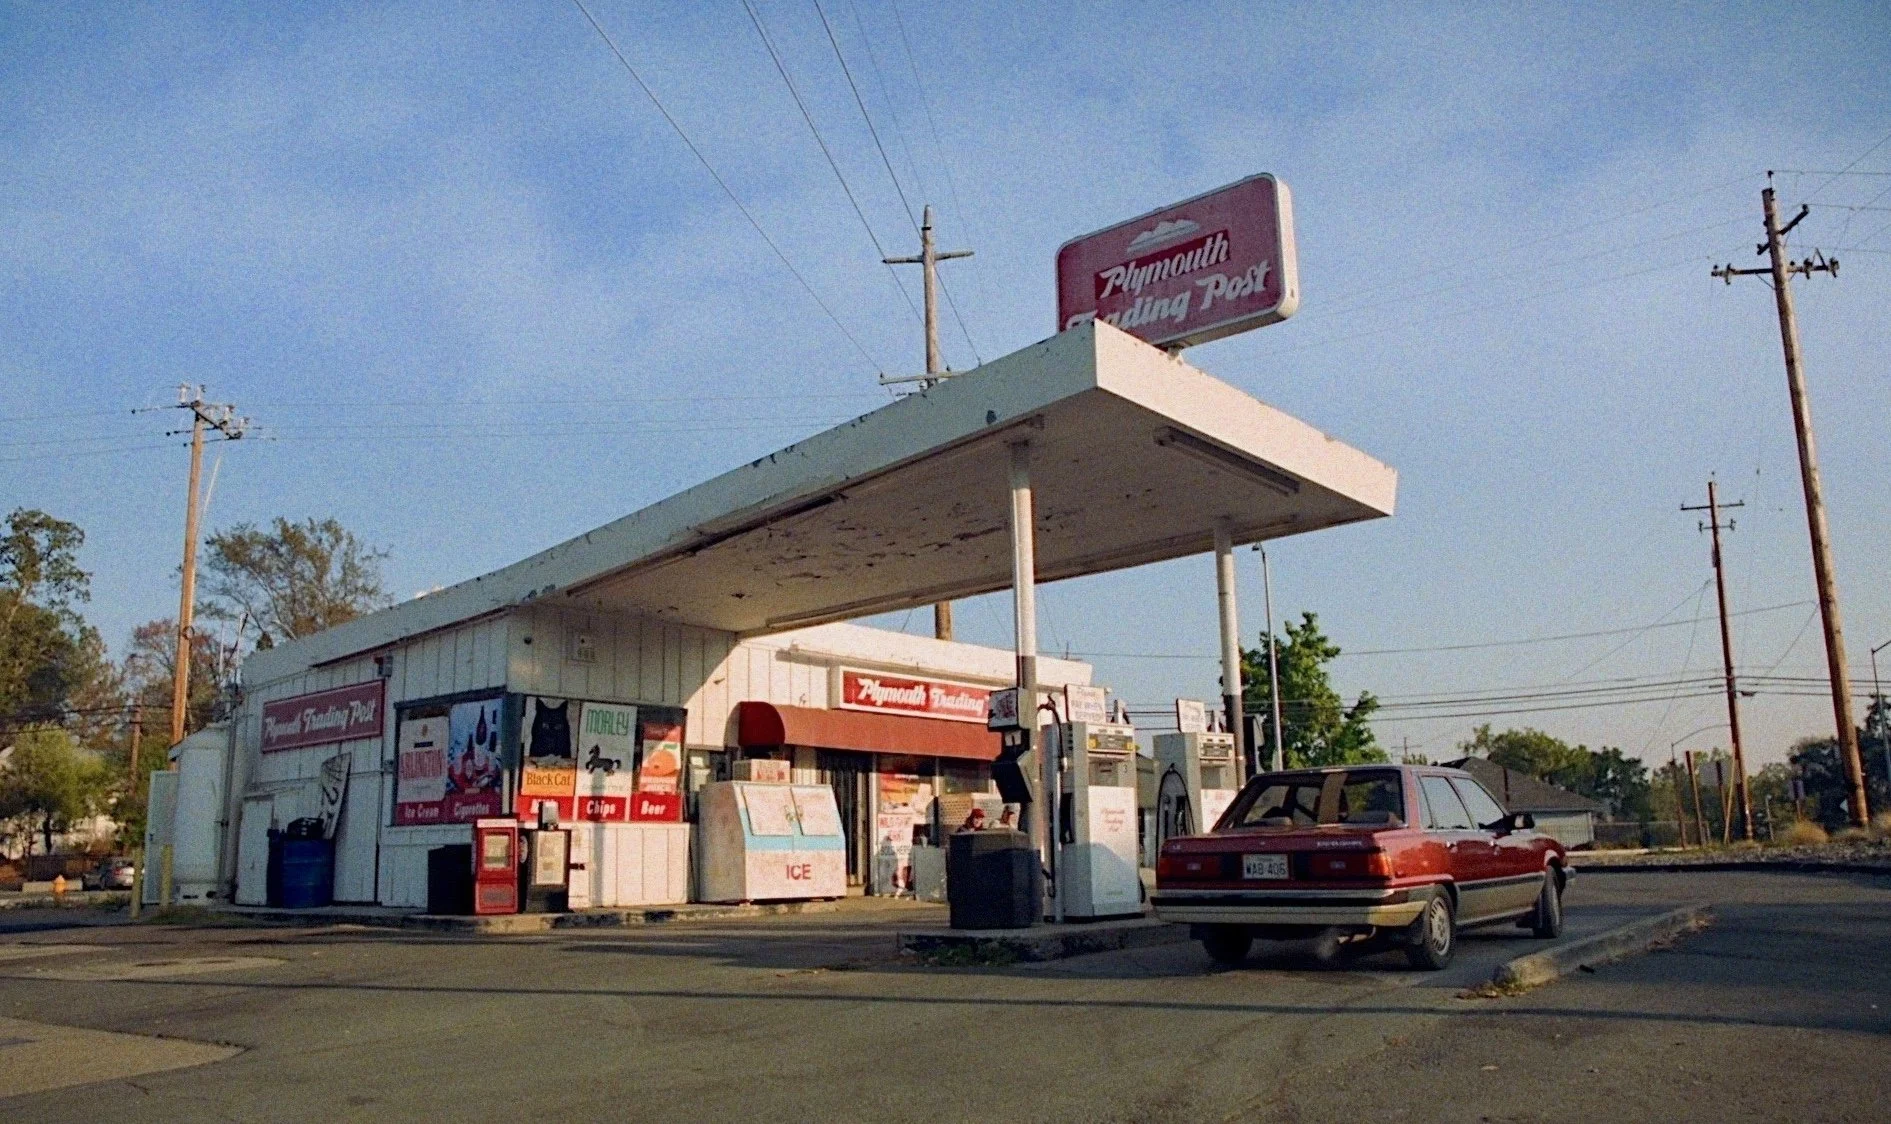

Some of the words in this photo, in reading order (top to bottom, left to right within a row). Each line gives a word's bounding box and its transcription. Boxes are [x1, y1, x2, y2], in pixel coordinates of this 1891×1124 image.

[1099, 231, 1229, 298] Plymouth
[1066, 291, 1191, 331] ading
[1196, 259, 1271, 310] Post
[858, 678, 926, 706] Plymouth
[930, 687, 984, 716] Trading
[349, 699, 376, 726] Post
[586, 708, 630, 737] MORLEY
[526, 773, 552, 786] Black
[554, 774, 571, 786] Cat
[586, 801, 616, 816] Chips
[641, 801, 667, 816] Beer
[786, 864, 811, 880] ICE
